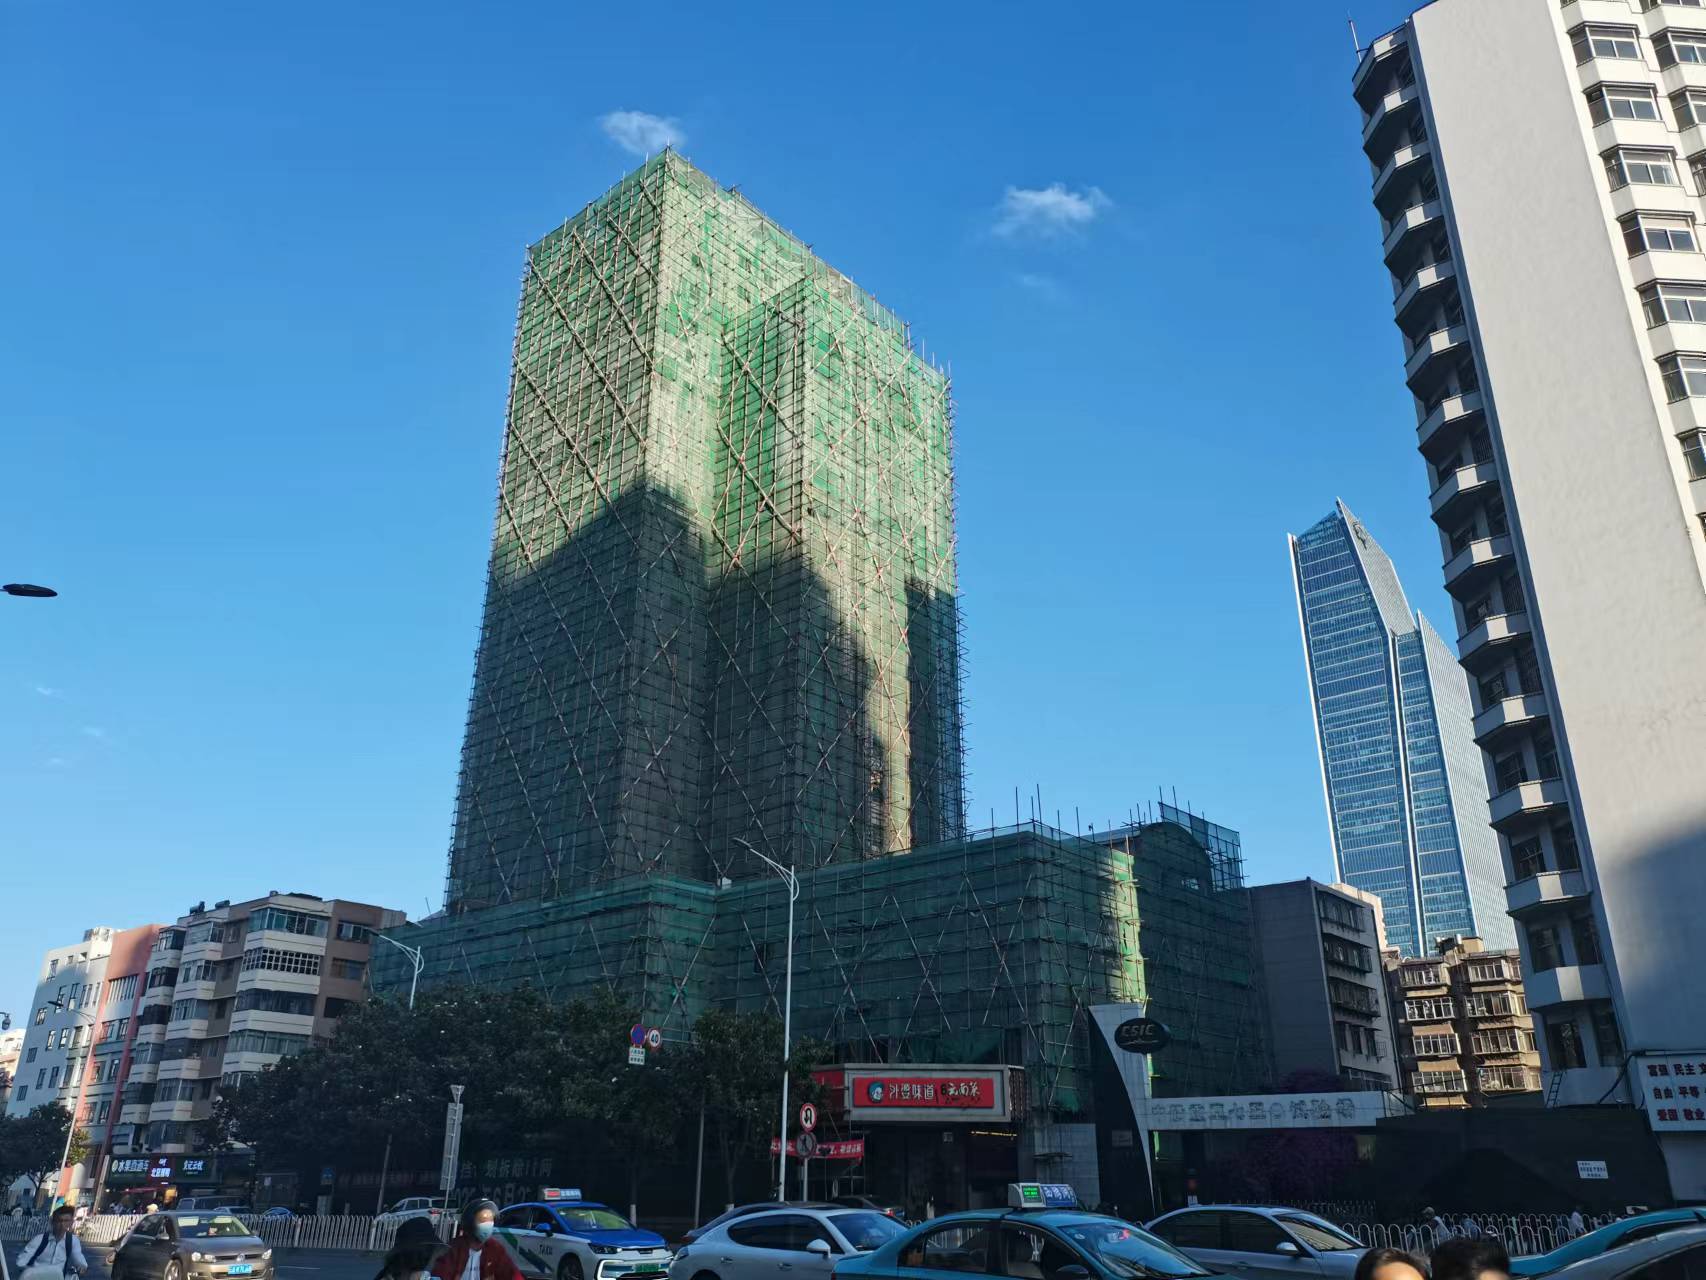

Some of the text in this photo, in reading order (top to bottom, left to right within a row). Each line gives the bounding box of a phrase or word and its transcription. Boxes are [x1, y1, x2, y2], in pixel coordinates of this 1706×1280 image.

[650, 1033, 659, 1044] 40
[1647, 1064, 1669, 1076] 富强
[1673, 1063, 1696, 1076] 民主
[889, 1082, 935, 1100] 外婆味道
[1653, 1086, 1700, 1100] 自由 平等
[1657, 1108, 1706, 1121] 爱国 敬业
